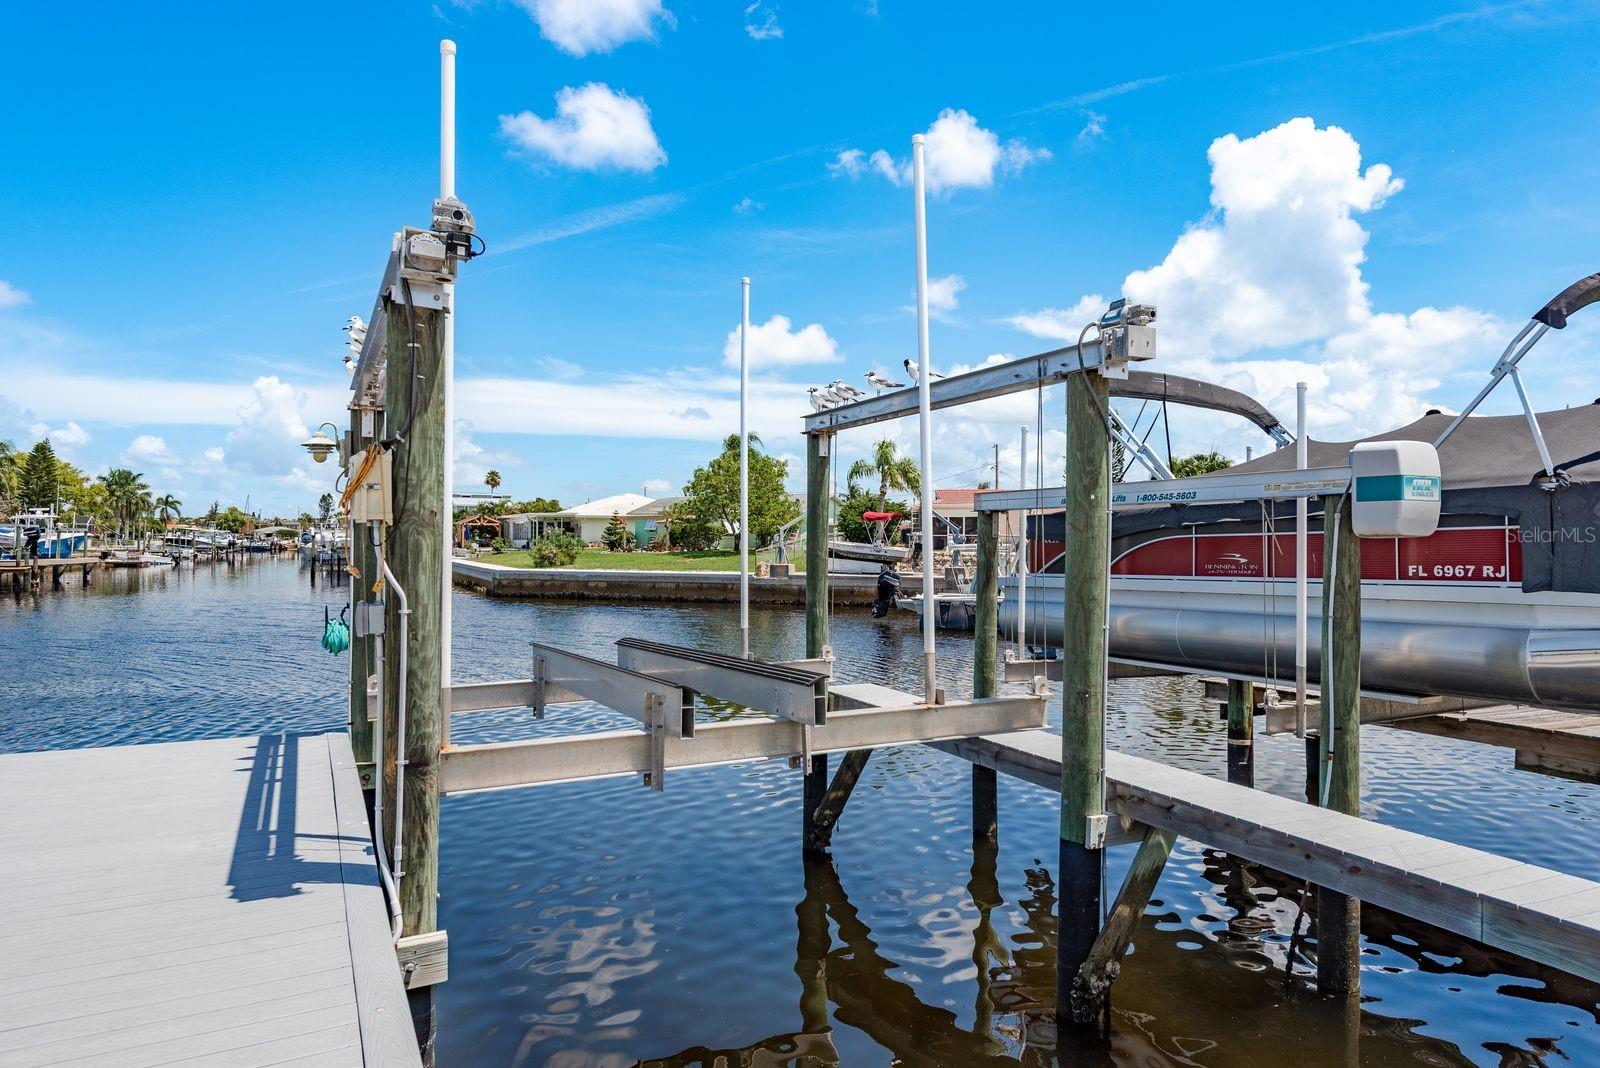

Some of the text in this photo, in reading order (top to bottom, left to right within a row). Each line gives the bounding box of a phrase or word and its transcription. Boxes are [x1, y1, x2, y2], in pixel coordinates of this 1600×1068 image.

[1112, 491, 1197, 502] Lifts 1-800-545-5603
[1408, 565, 1506, 577] FL 6967 RJ
